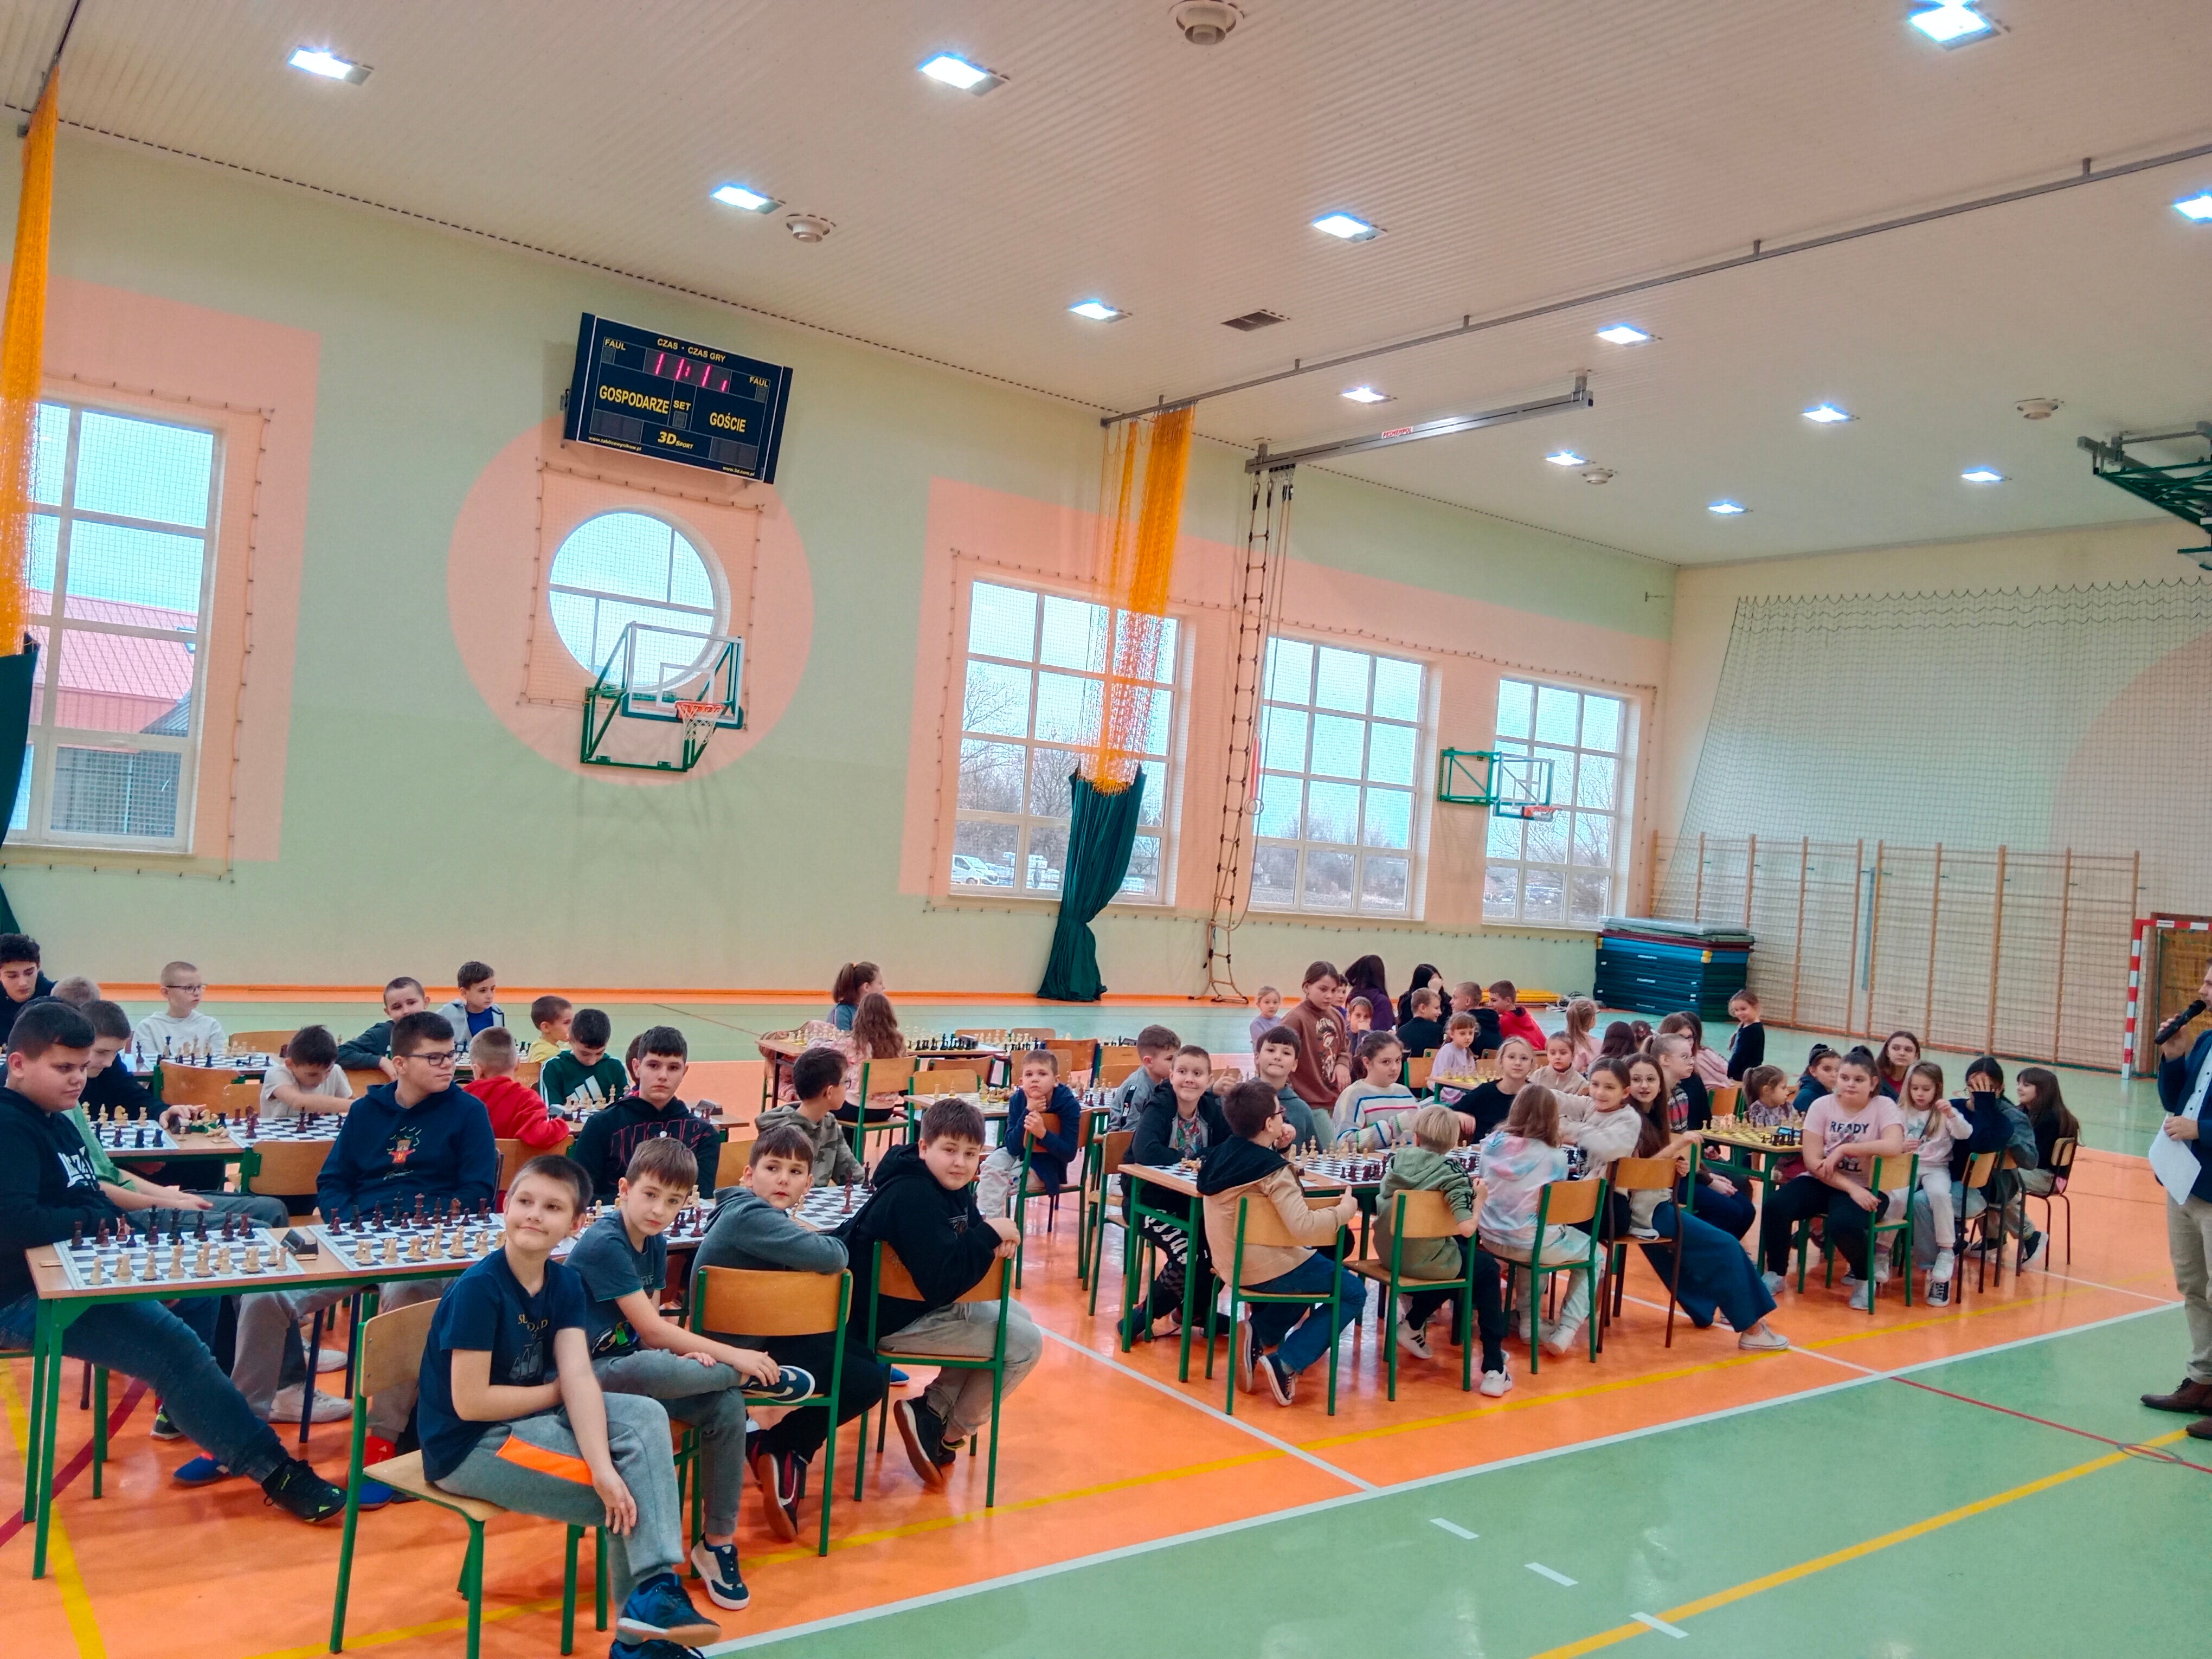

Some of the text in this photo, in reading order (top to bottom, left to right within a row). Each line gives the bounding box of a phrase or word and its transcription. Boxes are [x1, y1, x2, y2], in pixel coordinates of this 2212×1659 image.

[605, 339, 626, 351] FAUL
[657, 338, 726, 363] CZAS CZAS GRY
[749, 376, 769, 388] FAUL
[599, 385, 670, 414] GOSPODARZE
[673, 400, 691, 411] SET
[710, 412, 747, 433] GOŚCIE
[1829, 1121, 1870, 1134] READY
